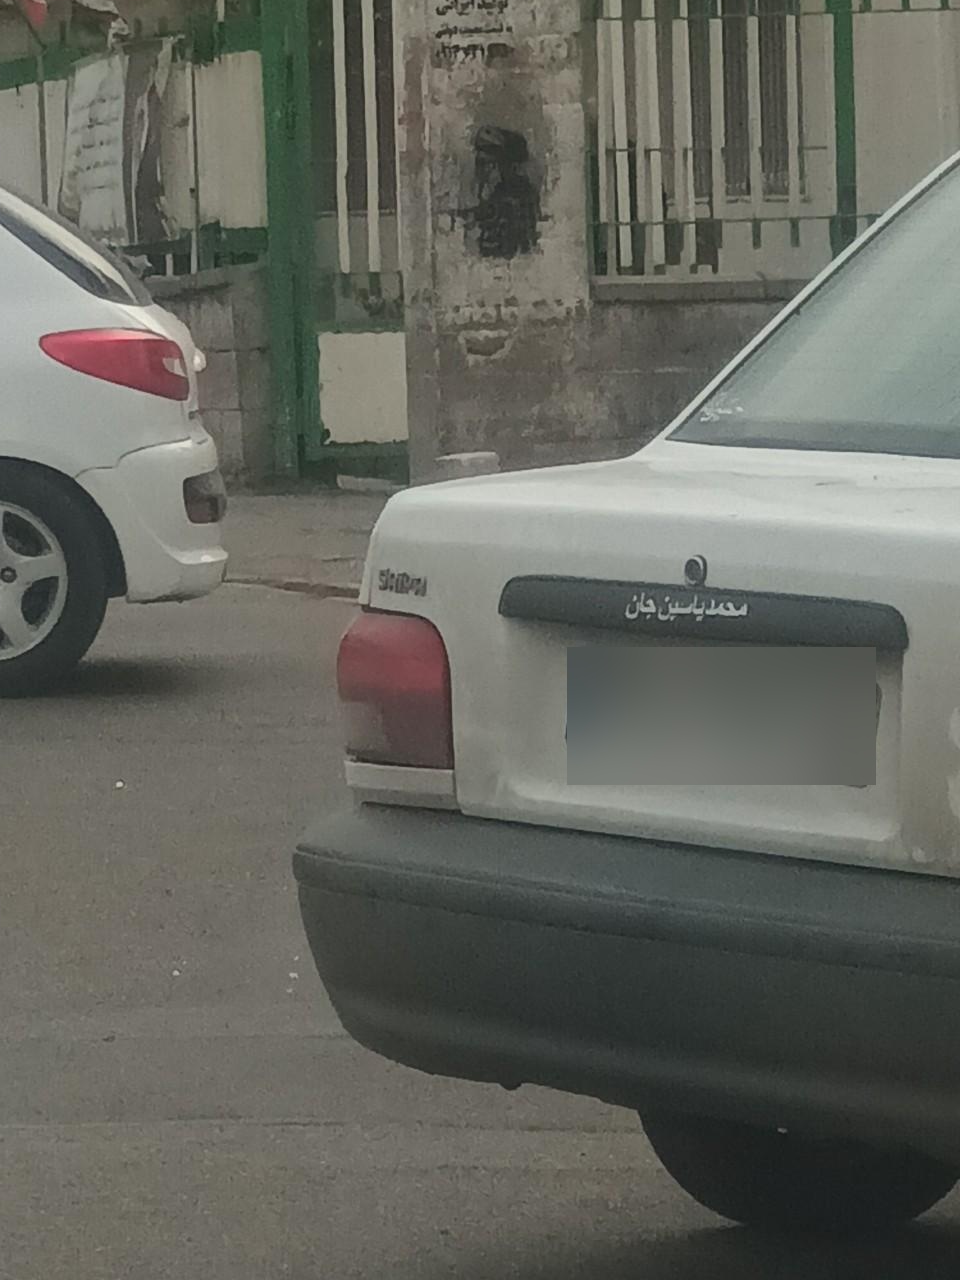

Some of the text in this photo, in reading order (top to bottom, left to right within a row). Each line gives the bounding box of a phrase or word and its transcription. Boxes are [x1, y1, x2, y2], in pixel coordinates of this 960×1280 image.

[625, 592, 749, 622] محمد یاسین جان
